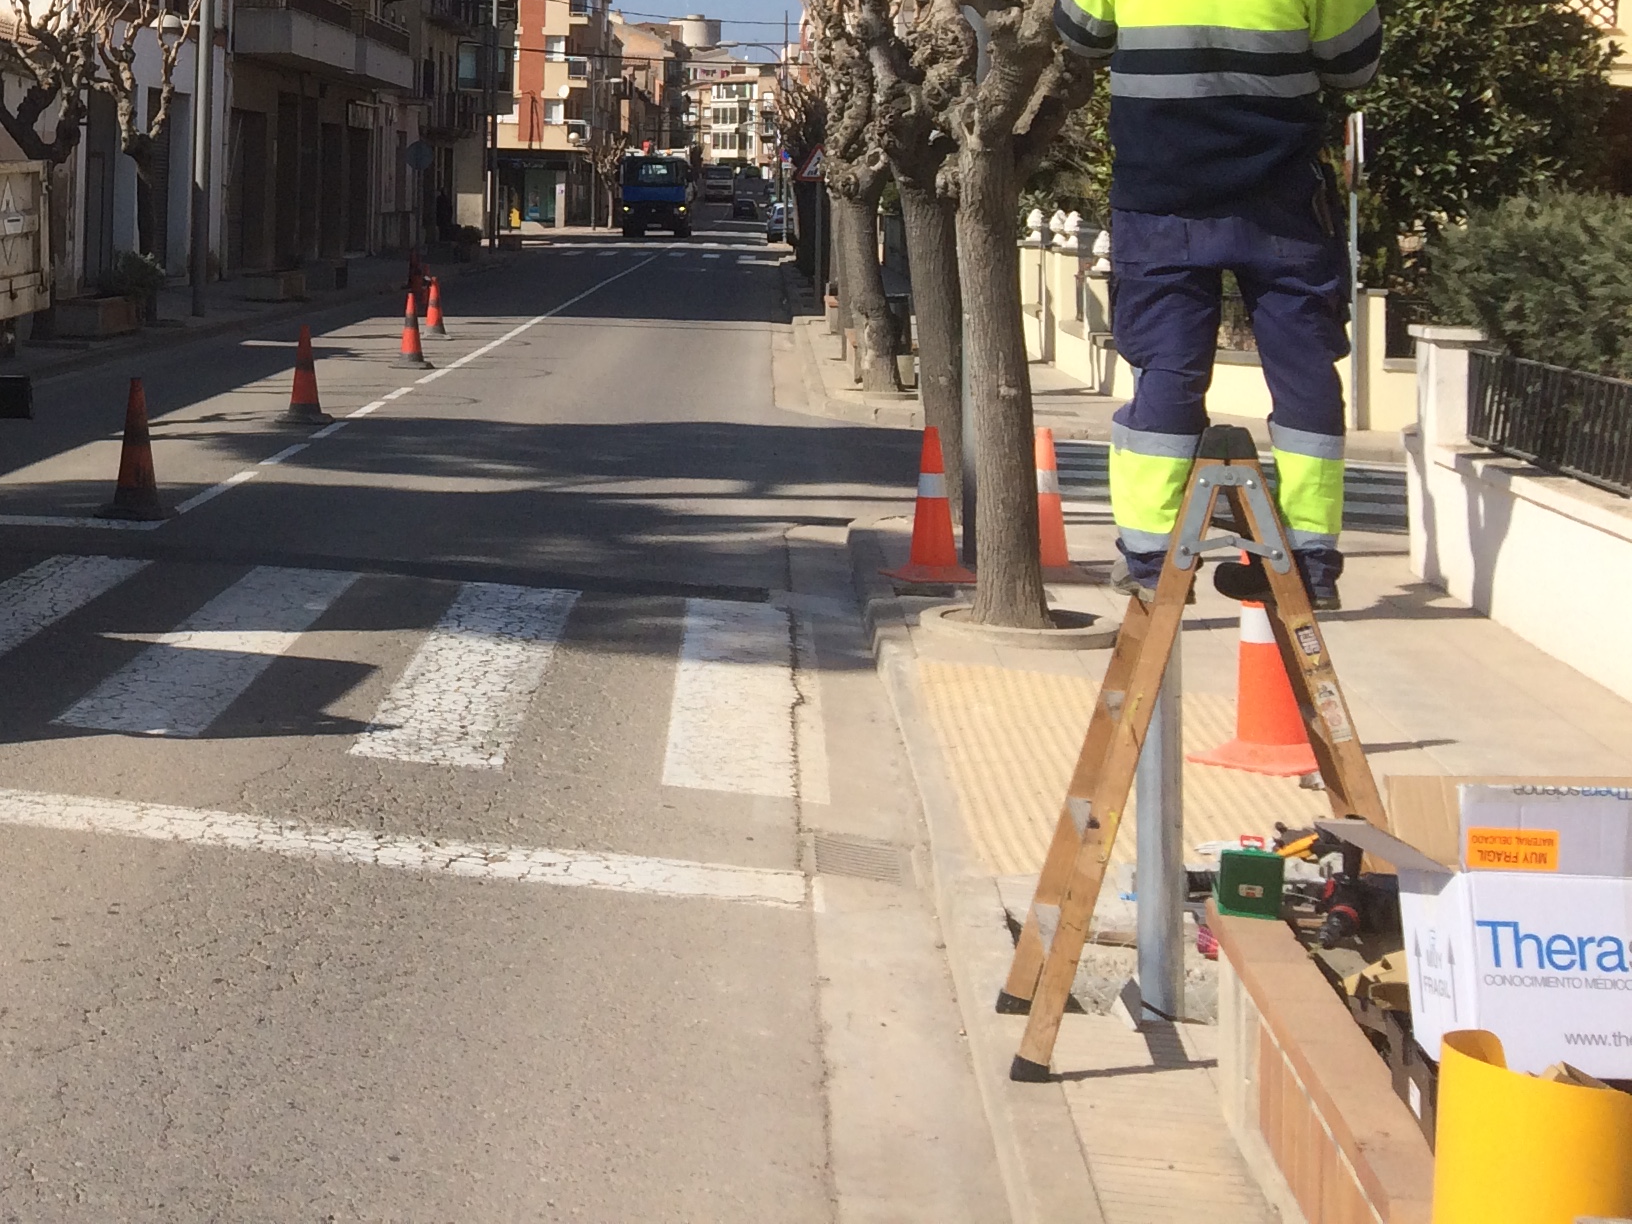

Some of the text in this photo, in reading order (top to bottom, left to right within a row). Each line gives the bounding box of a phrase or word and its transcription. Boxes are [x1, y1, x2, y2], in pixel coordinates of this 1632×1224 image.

[1472, 834, 1554, 847] MATERIAL DELICADO
[1477, 849, 1548, 865] MUY FRAGIL
[1475, 920, 1632, 973] Thera
[1426, 948, 1443, 970] MUY
[1484, 974, 1583, 990] CONOCIMIENTO
